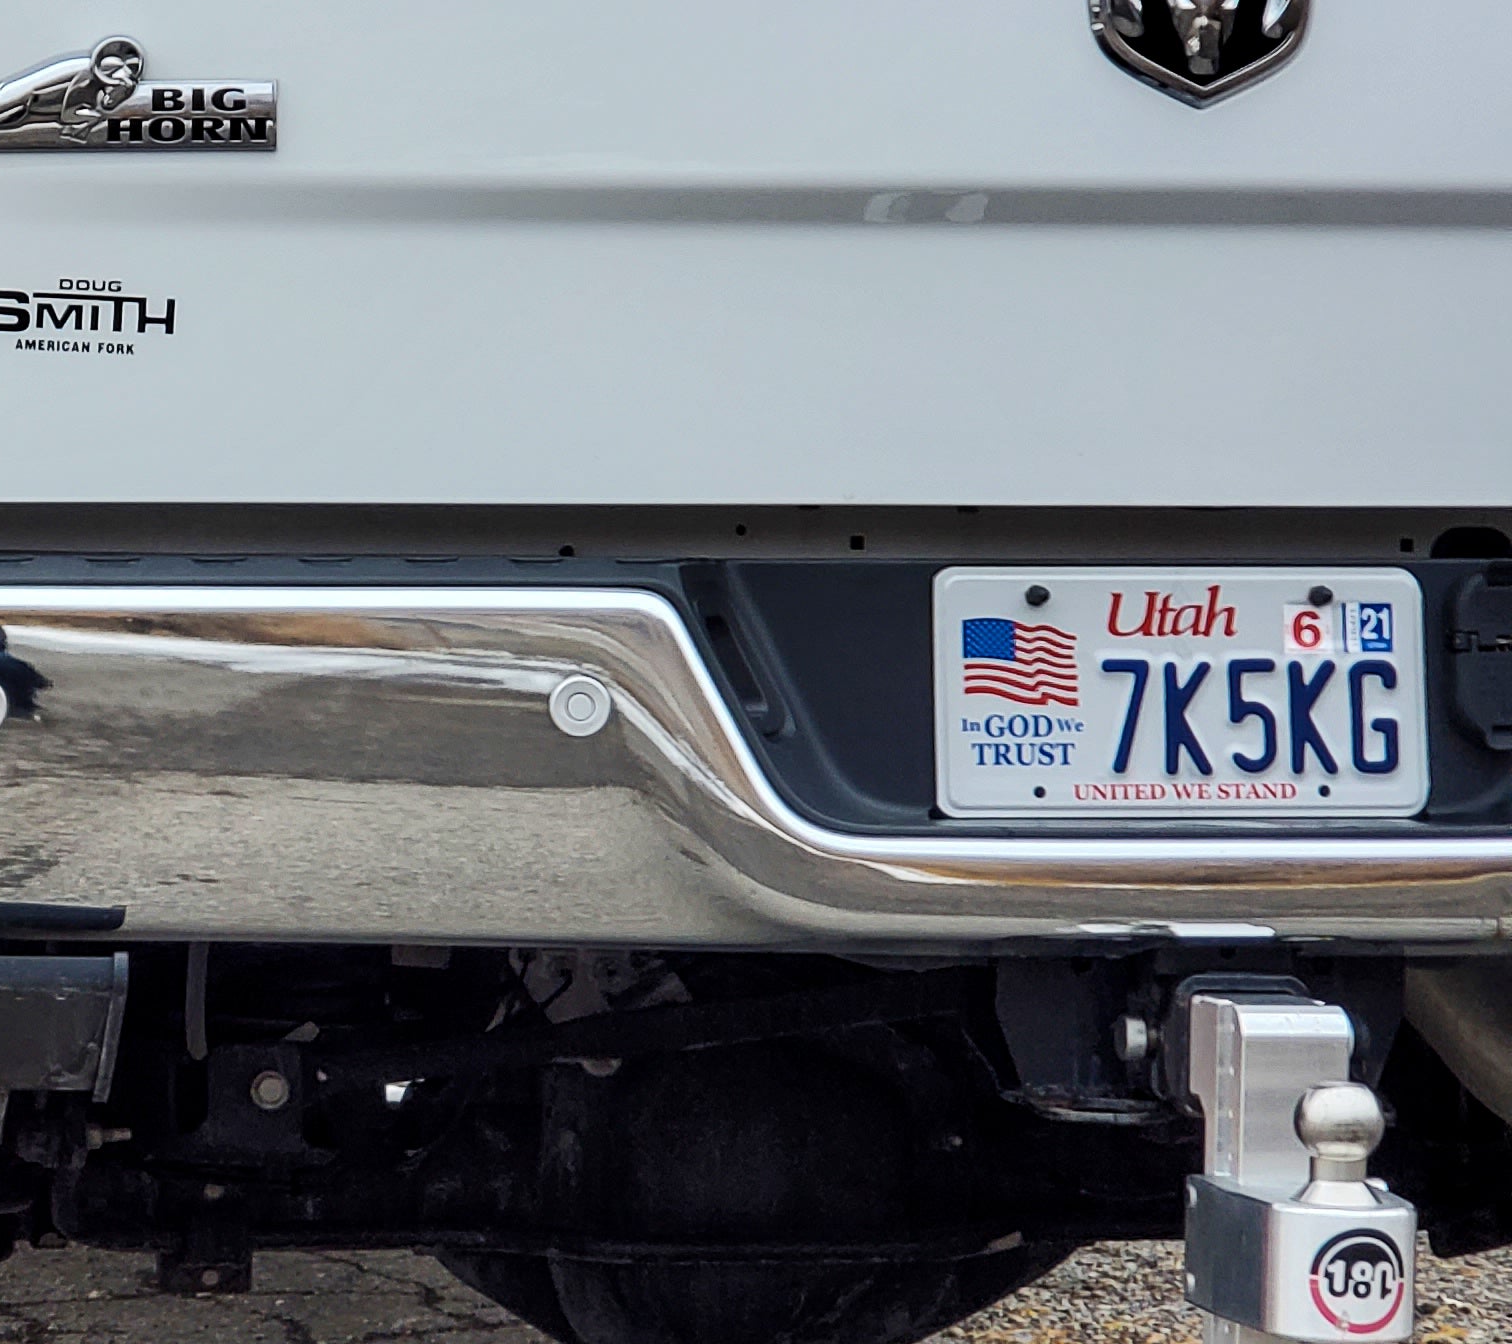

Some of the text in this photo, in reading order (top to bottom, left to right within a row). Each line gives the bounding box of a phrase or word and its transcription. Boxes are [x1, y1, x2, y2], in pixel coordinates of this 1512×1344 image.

[151, 88, 247, 112] BIG
[107, 117, 268, 142] HORN
[59, 278, 123, 292] DOUG
[15, 338, 135, 355] AMERICAN FORK
[1108, 585, 1238, 637] Utah
[1293, 611, 1321, 648] 6
[1361, 607, 1390, 640] 21
[961, 714, 1085, 737] In GOD We
[1102, 659, 1399, 775] 7K5KG
[971, 742, 1076, 766] TRUST
[1073, 784, 1296, 800] UNITED WE STAND
